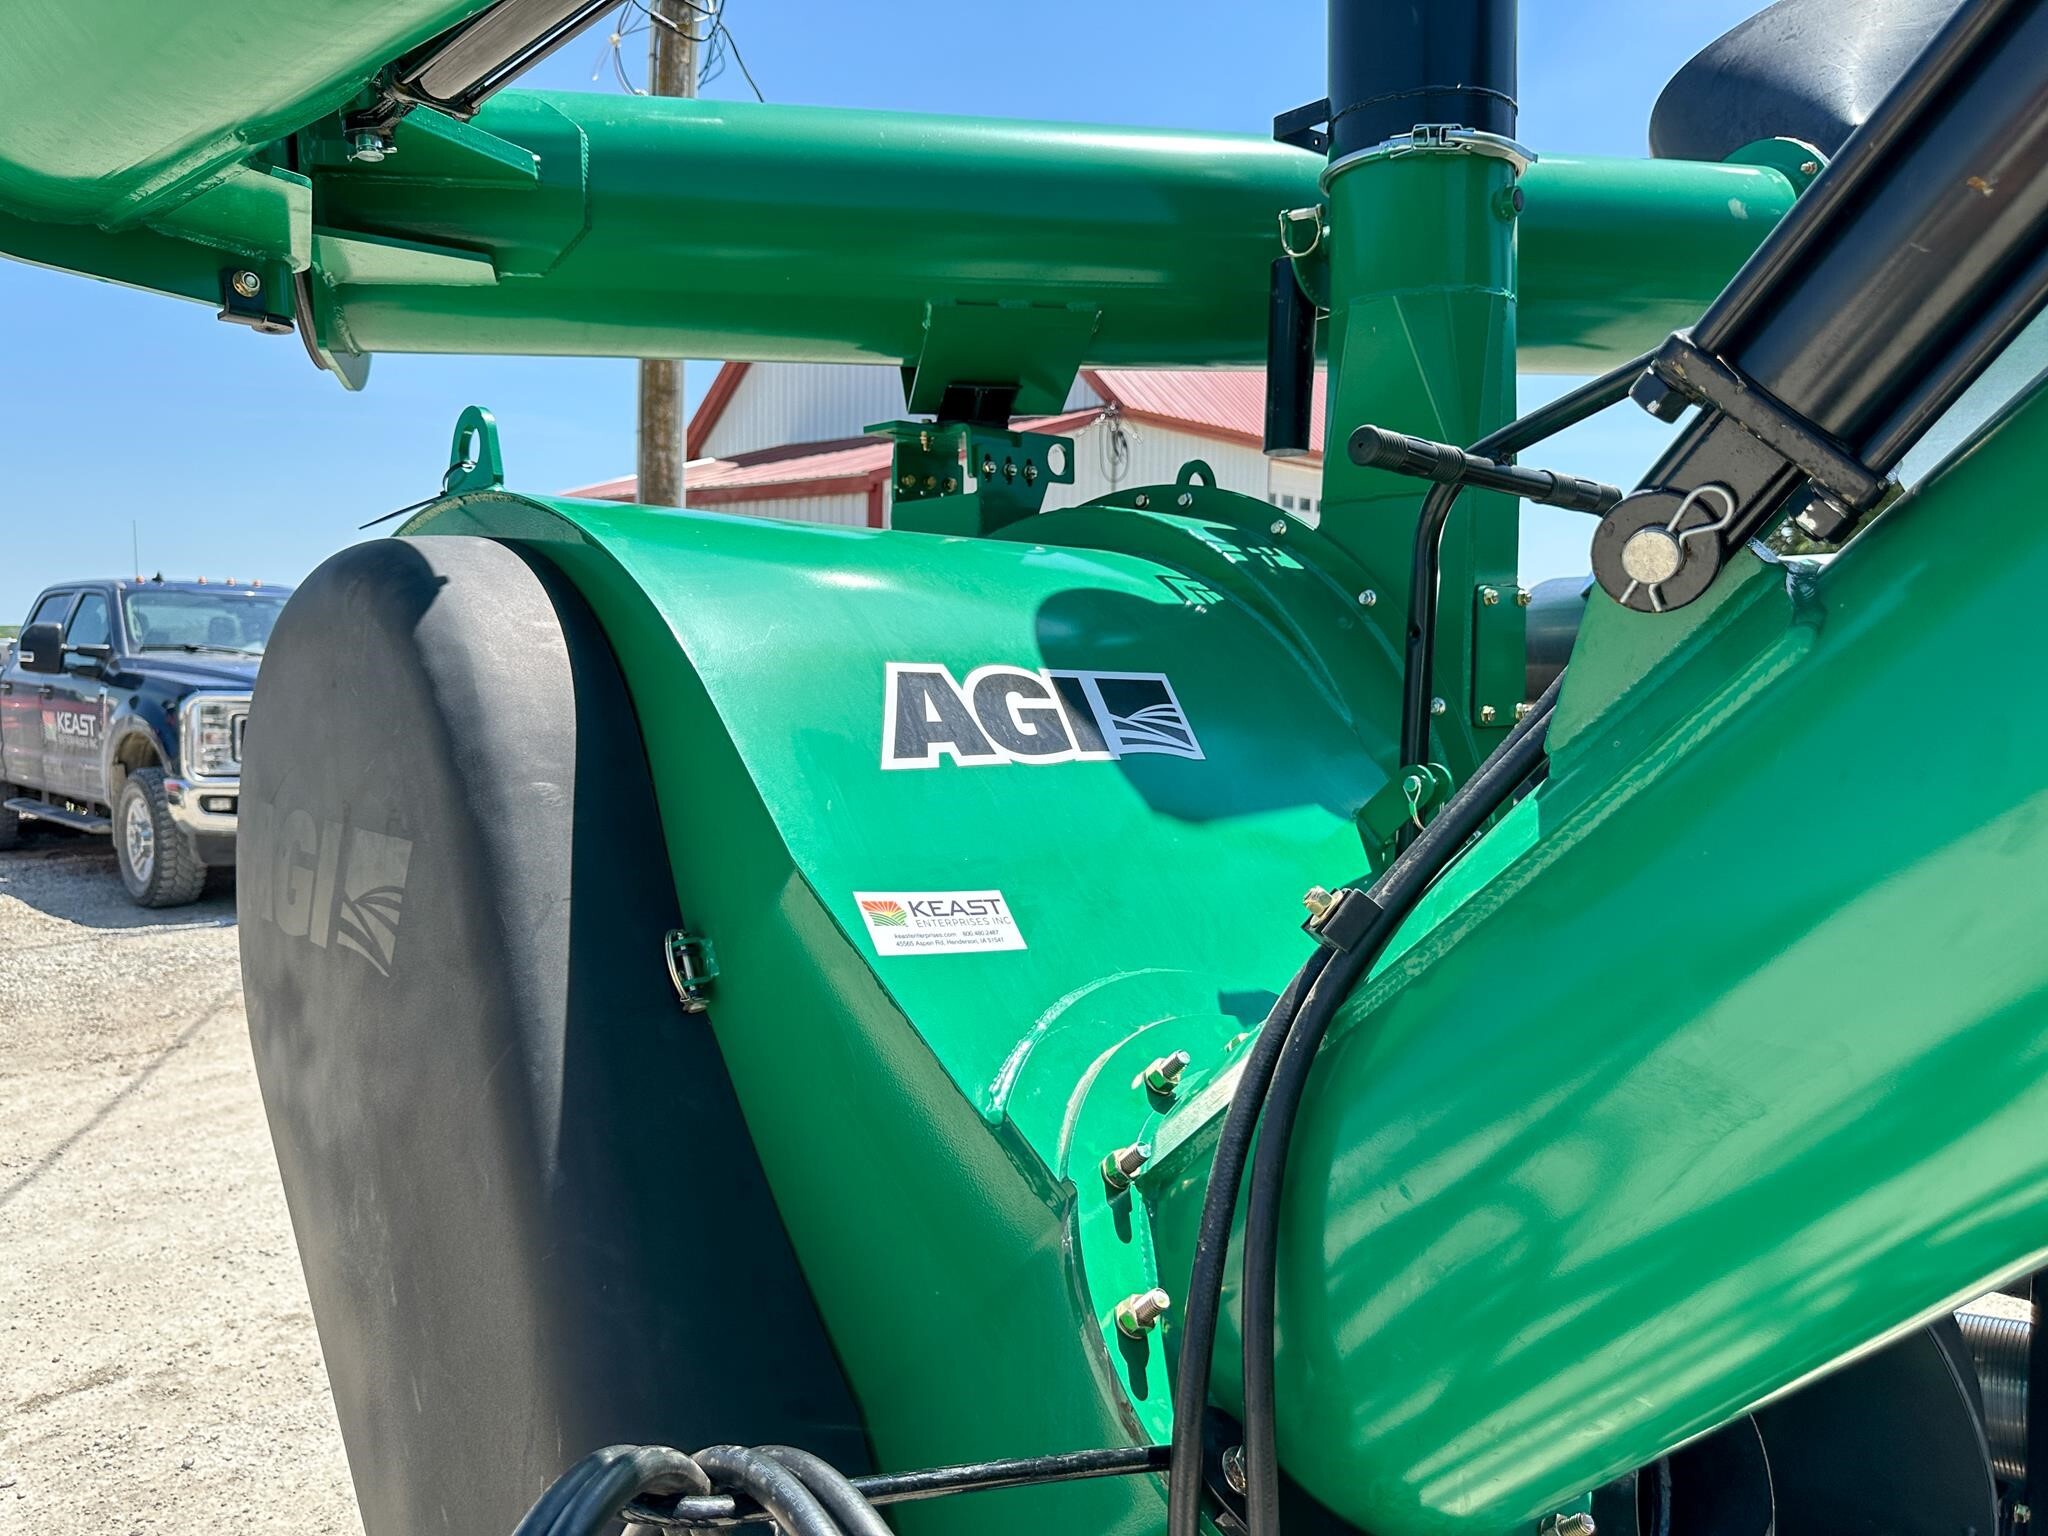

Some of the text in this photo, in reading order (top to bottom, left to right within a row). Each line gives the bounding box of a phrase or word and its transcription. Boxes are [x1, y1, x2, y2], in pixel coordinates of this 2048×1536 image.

[57, 711, 96, 737] KEAST
[893, 671, 1111, 759] AGI
[908, 899, 1000, 917] KEAST
[916, 916, 1011, 928] ENTERPRISES INC
[946, 937, 979, 945] Henderson,
